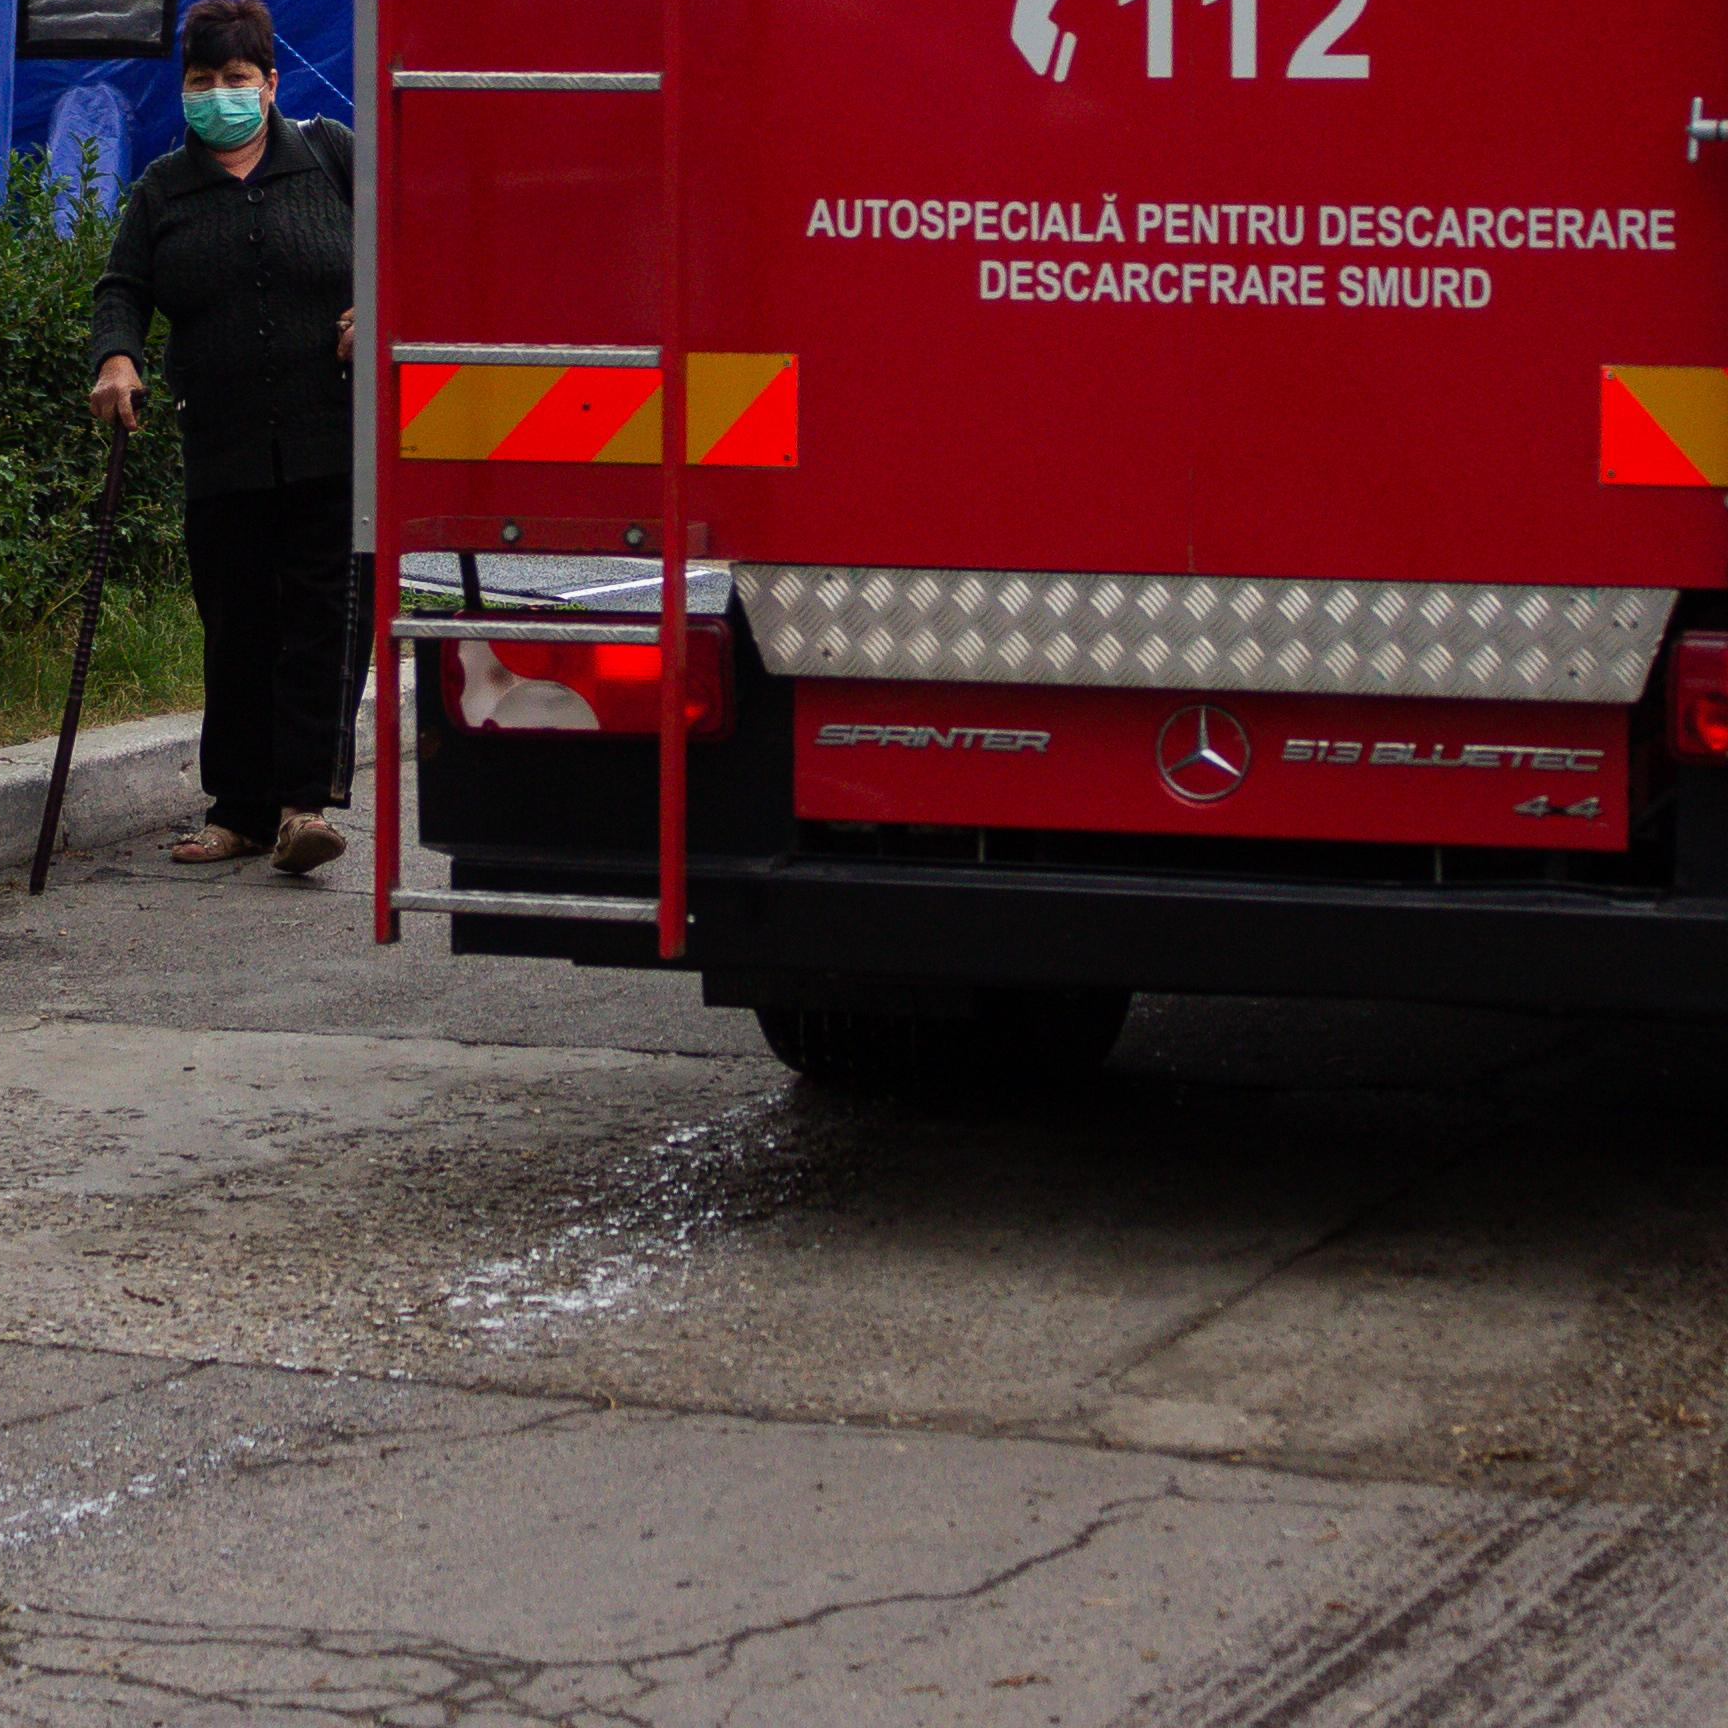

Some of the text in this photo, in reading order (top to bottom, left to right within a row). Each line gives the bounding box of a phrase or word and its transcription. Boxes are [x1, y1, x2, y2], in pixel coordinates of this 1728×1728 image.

[806, 193, 1676, 250] AUTOSPECIALĂ PENTRU DESCARCERARE
[1338, 265, 1492, 309] SMURD
[815, 724, 1051, 753] SPRINTER
[1282, 739, 1604, 771] 513 BLUETEC
